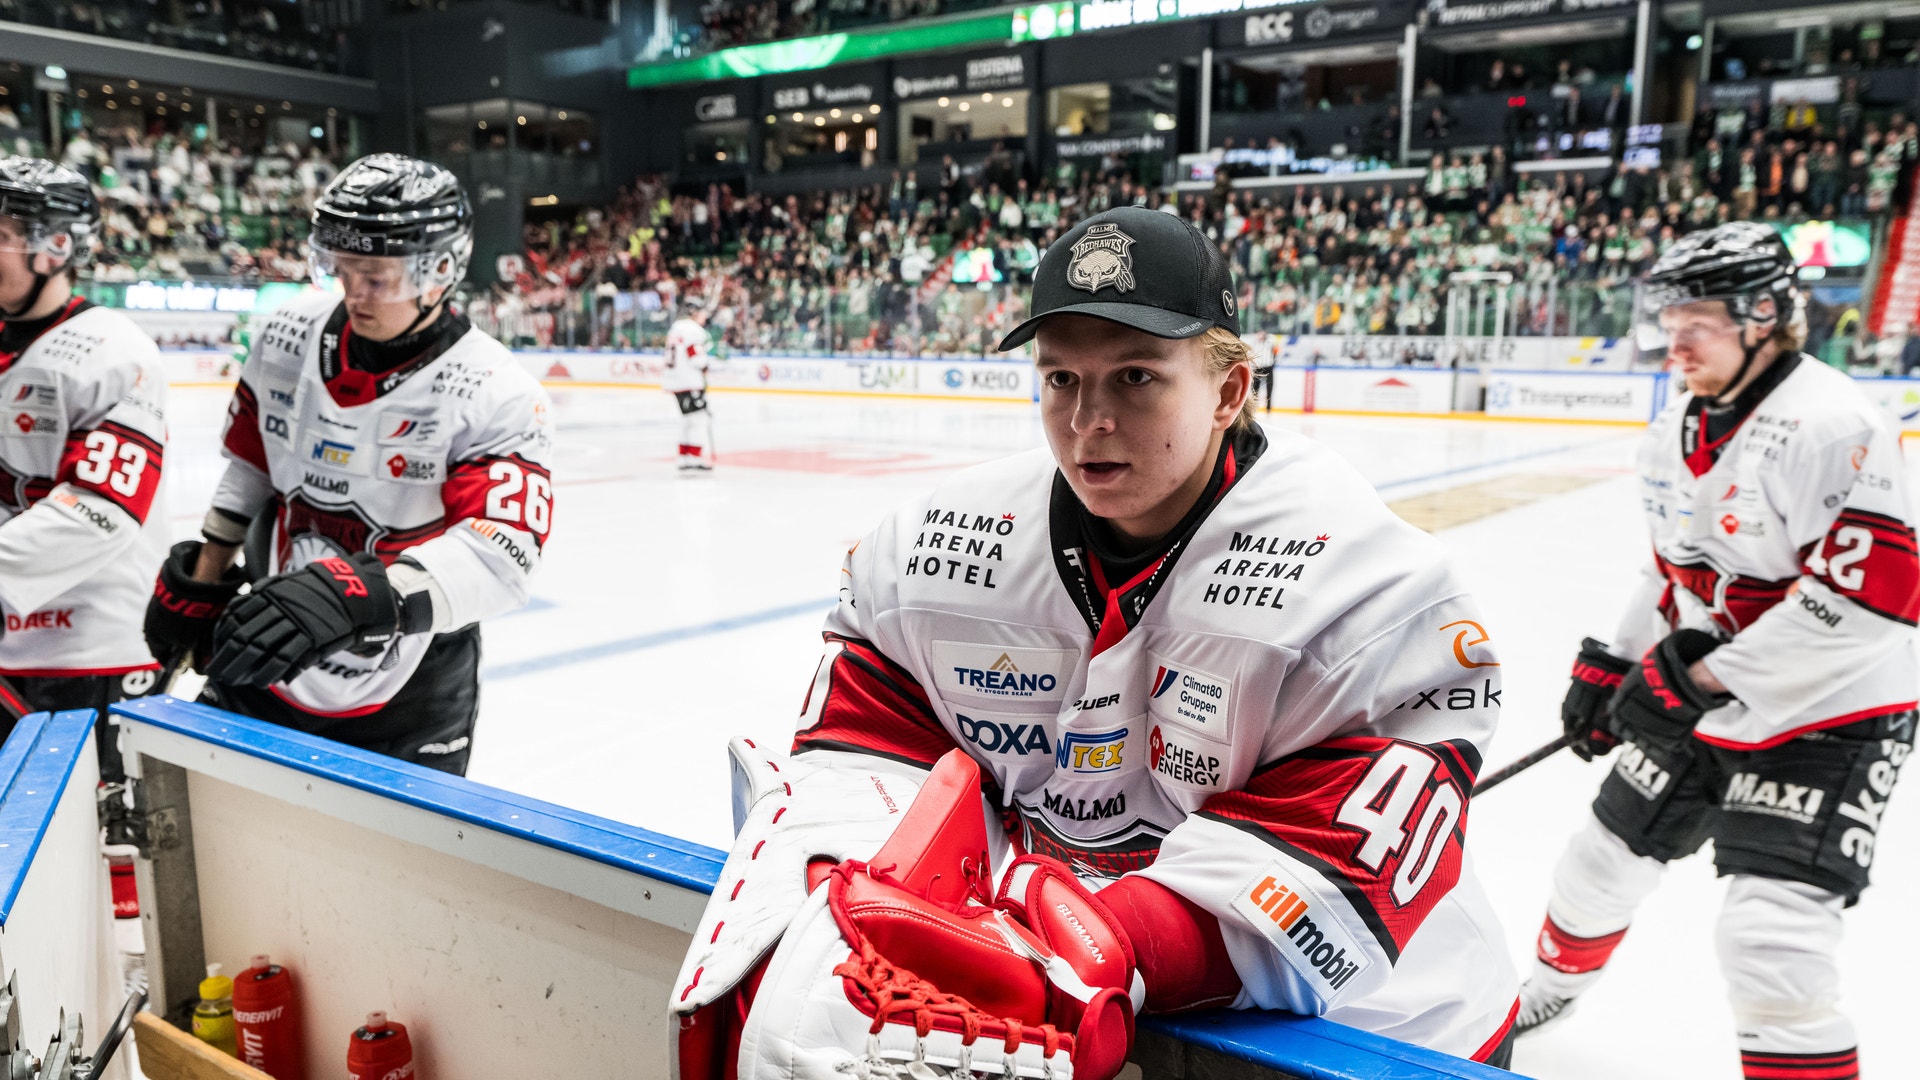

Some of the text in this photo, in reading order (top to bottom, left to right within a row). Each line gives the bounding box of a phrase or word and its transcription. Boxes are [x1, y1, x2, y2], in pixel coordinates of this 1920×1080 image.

[1245, 12, 1294, 43] RCC
[1080, 238, 1123, 257] REDHAWKS
[76, 431, 147, 495] 33
[485, 461, 551, 535] 26
[913, 532, 1003, 561] ARENA
[906, 555, 997, 589] HOTEL
[1214, 558, 1305, 581] ARENA
[1203, 583, 1285, 610] HOTEL
[954, 666, 1057, 692] TREANO
[984, 688, 1009, 696] BYGGER
[1011, 689, 1033, 697] SKÅNE
[1183, 675, 1222, 699] Climat80
[1180, 690, 1217, 714] Gruppen
[956, 713, 1052, 756] DOXA
[1166, 742, 1220, 770] CHEAP
[1158, 757, 1221, 787] ENERGY
[1724, 772, 1825, 818] MAXI
[1334, 743, 1462, 910] 40
[1056, 903, 1106, 965] BLOMMAN
[1249, 875, 1360, 991] tillmobil
